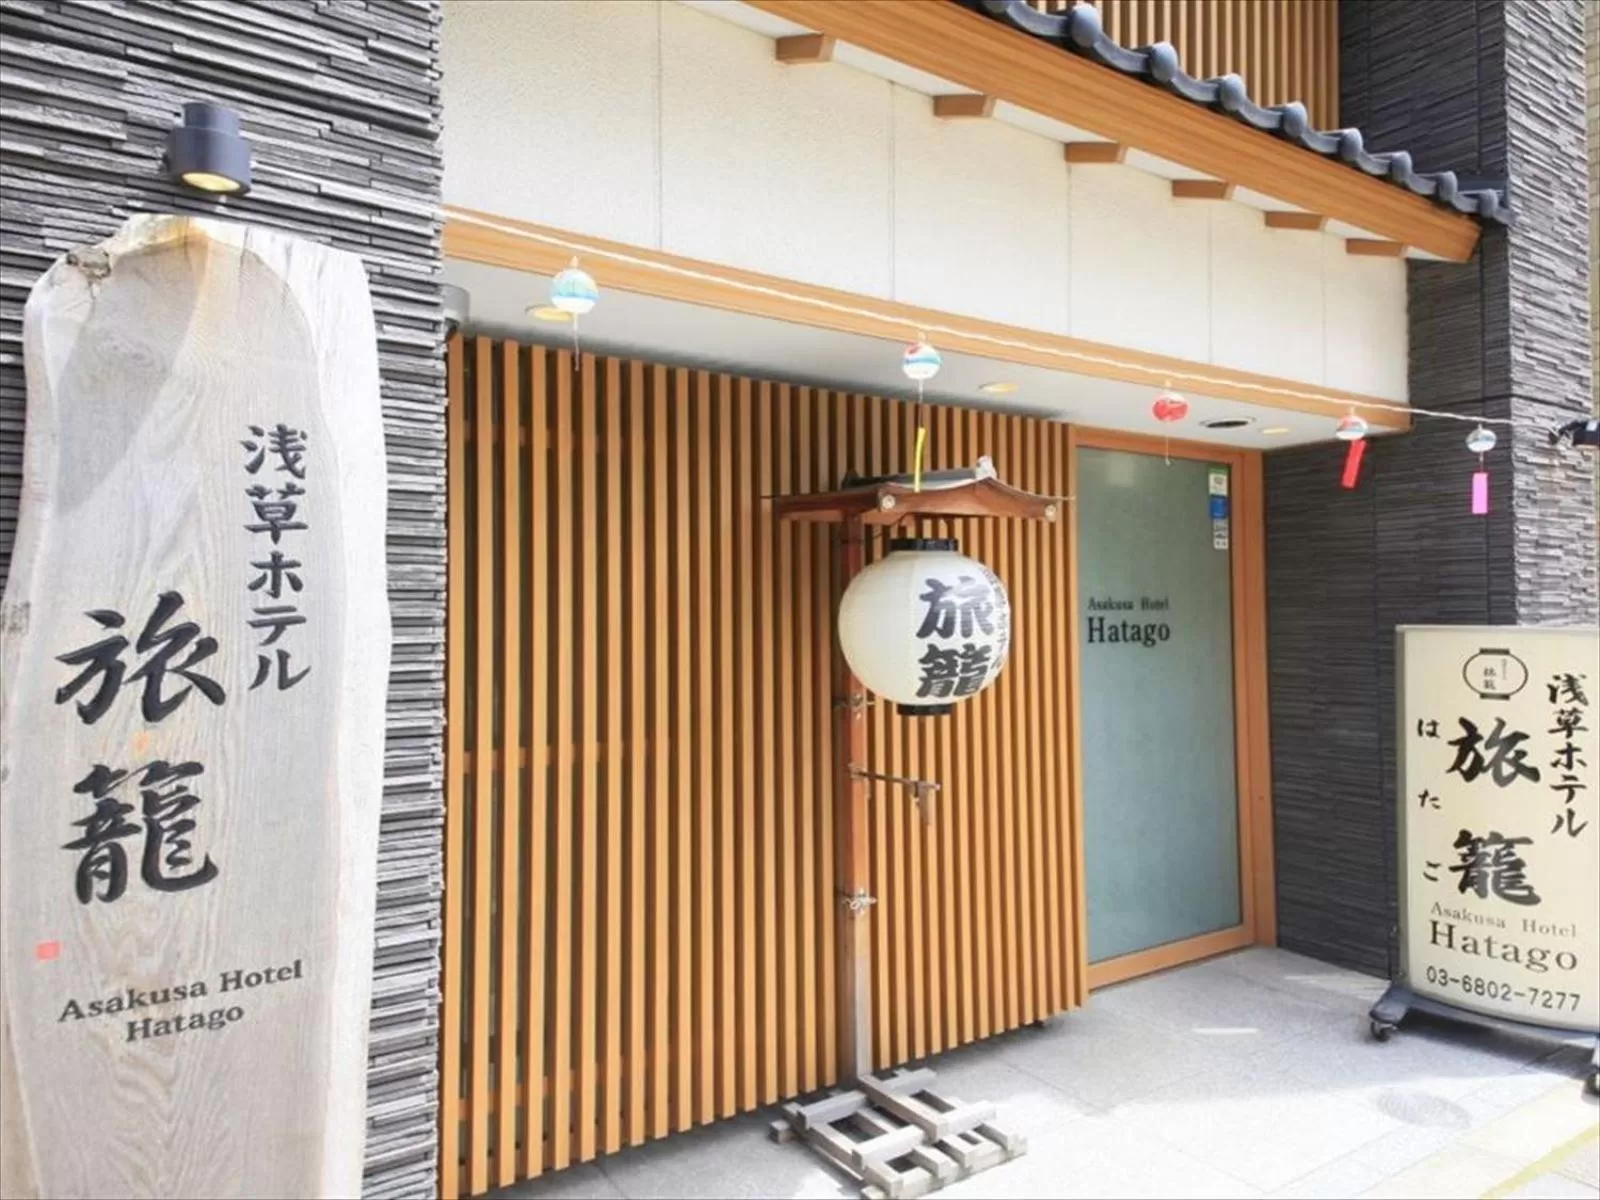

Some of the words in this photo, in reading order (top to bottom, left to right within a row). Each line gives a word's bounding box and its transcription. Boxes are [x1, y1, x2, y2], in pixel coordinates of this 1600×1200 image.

[240, 423, 311, 691] 浅草ホテル
[1087, 596, 1133, 611] Asakusa
[1140, 596, 1169, 611] Hotel
[1087, 616, 1171, 647] Hatago
[54, 590, 226, 905] 旅籠
[1546, 673, 1590, 837] 浅草ホテル
[1446, 716, 1541, 906] 旅籠
[1429, 919, 1578, 974] Hatago
[1430, 901, 1506, 929] Asakusa
[1522, 918, 1577, 938] Hotel
[58, 982, 207, 1023] Asakusa
[219, 959, 304, 993] Hotel
[1426, 965, 1582, 1012] 03-6802-7277
[125, 1005, 245, 1042] Hatago
